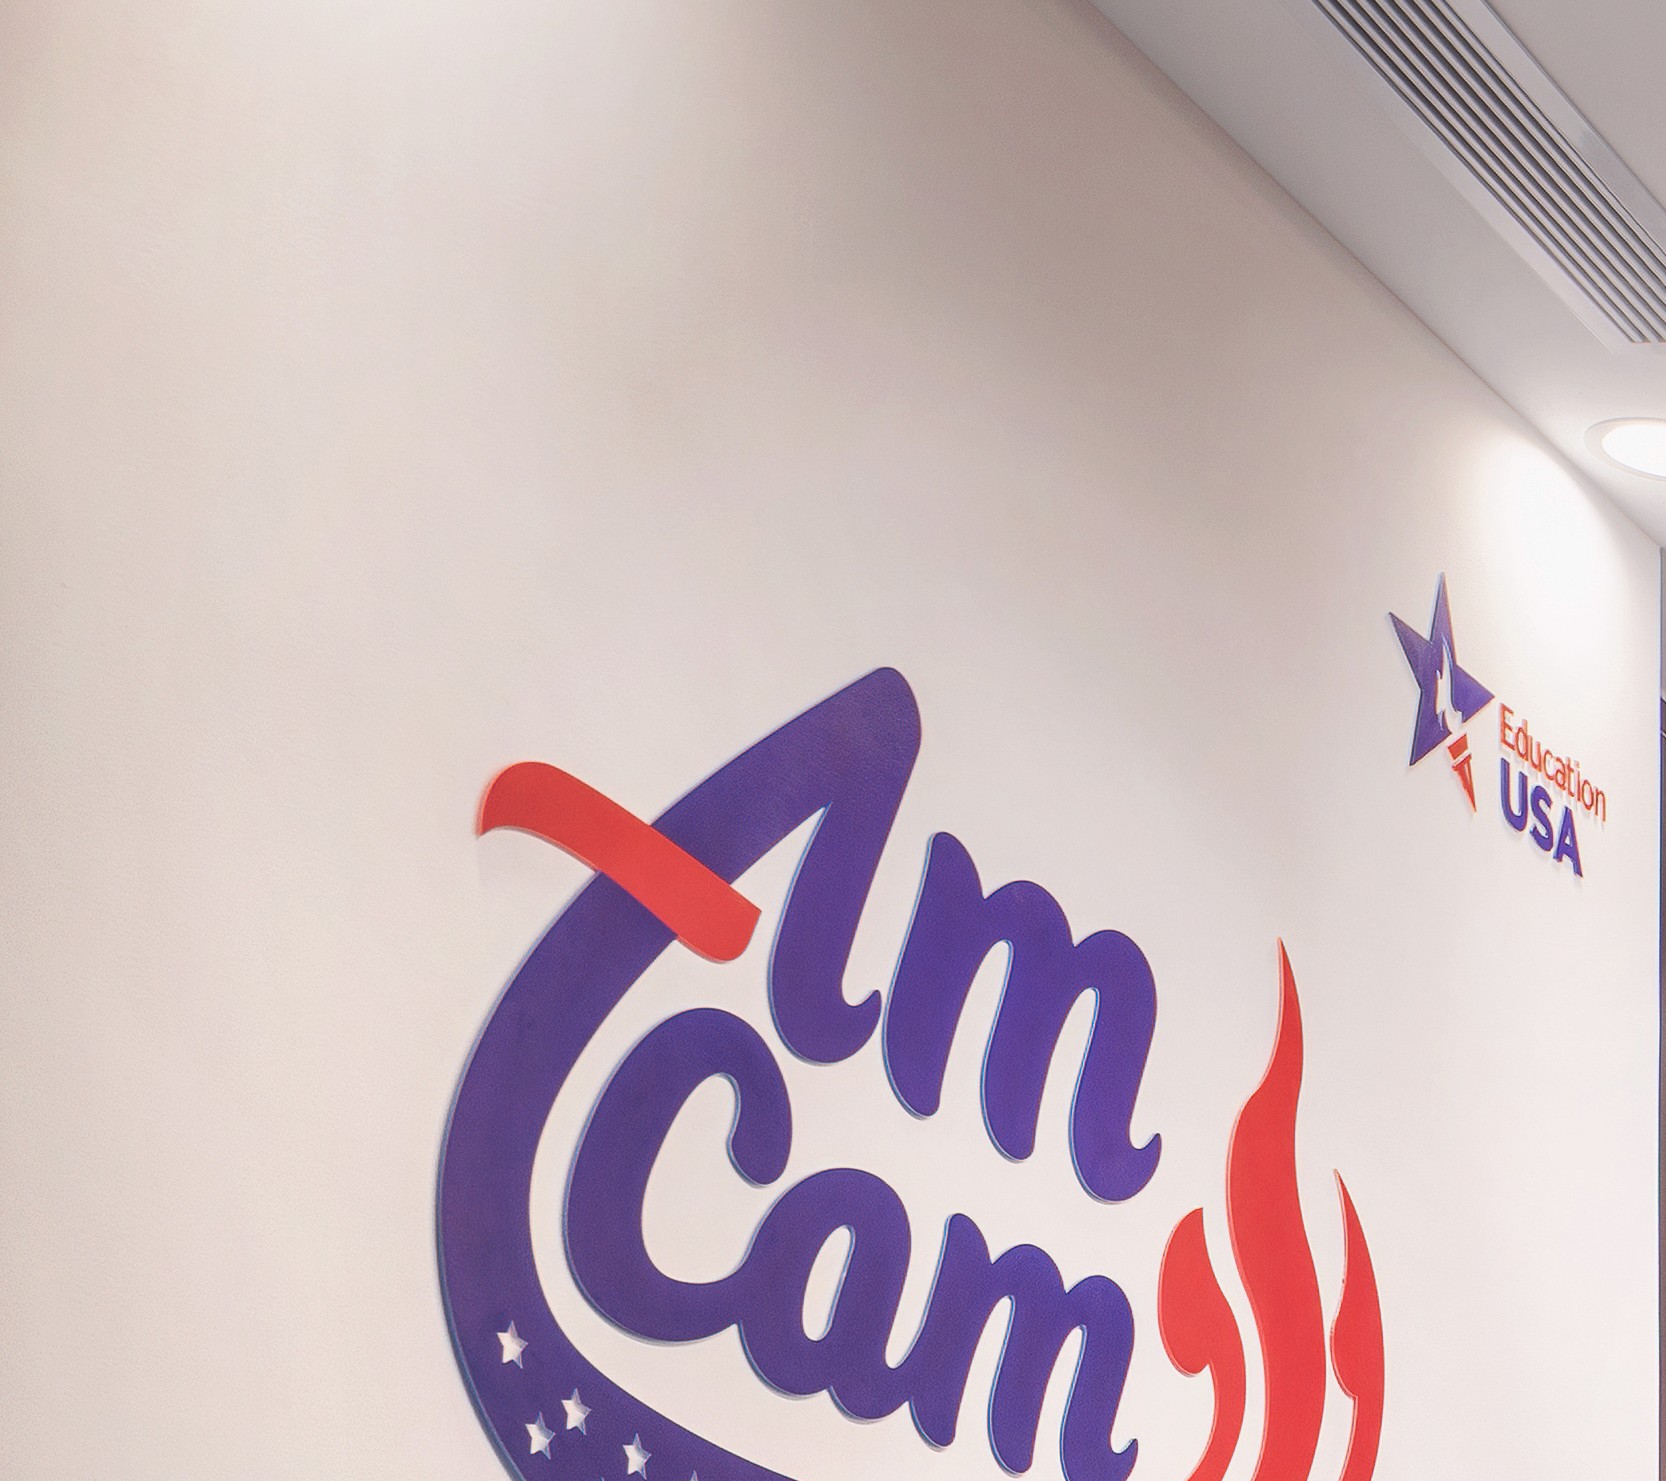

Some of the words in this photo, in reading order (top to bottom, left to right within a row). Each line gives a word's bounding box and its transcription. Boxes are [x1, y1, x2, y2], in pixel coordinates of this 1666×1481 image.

[1499, 703, 1607, 823] Education
[1499, 758, 1584, 877] USA
[475, 666, 1163, 1204] Am
